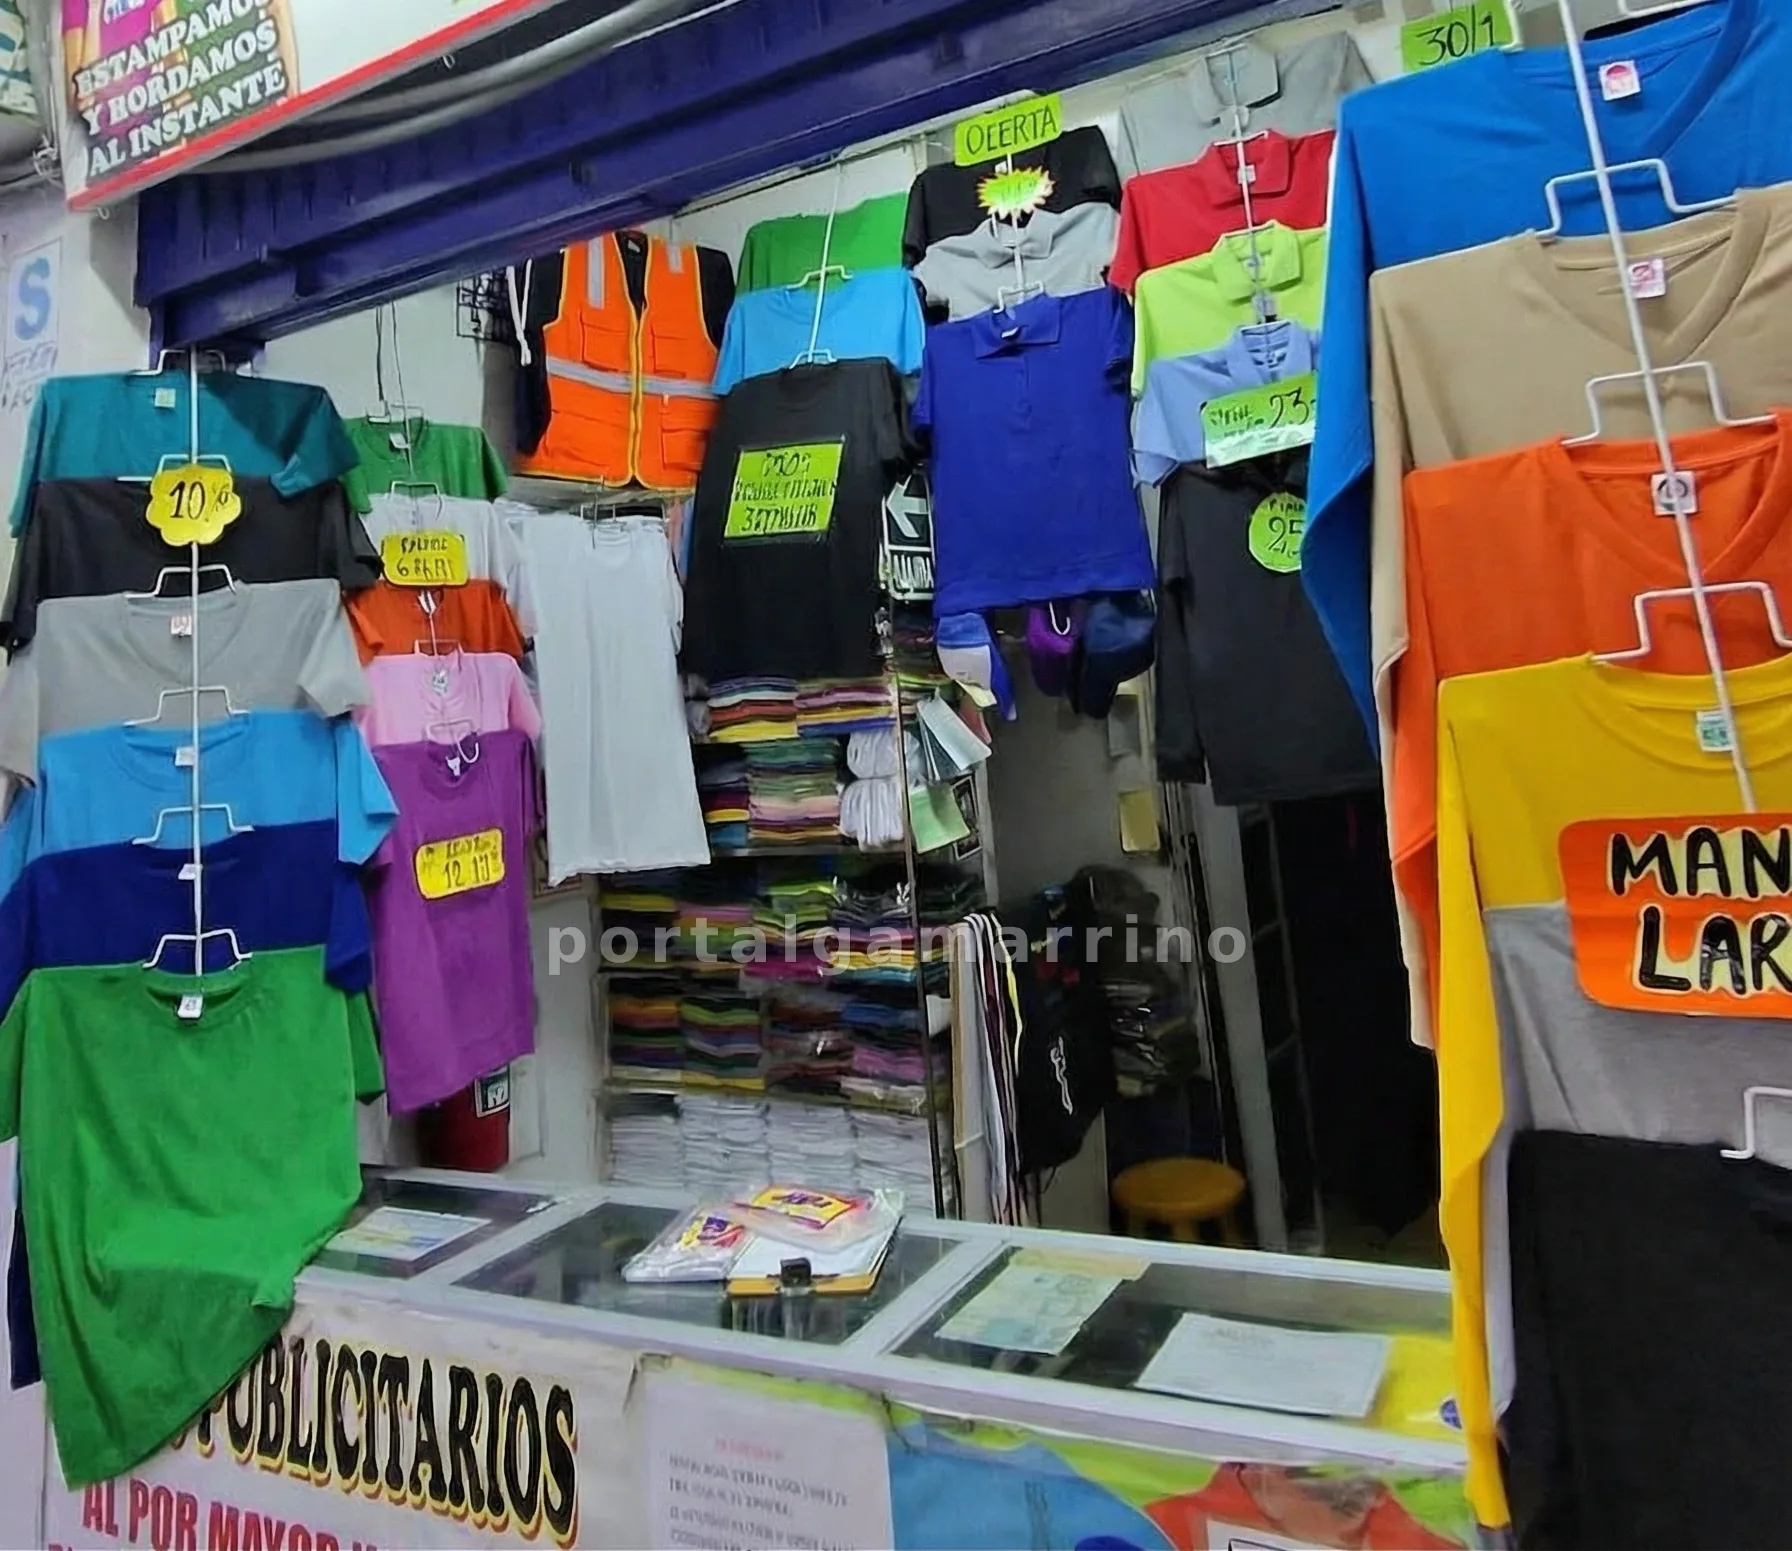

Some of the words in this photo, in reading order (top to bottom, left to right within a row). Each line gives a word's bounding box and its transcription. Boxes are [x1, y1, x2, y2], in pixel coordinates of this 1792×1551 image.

[75, 0, 269, 98] ESTAMPAMO
[83, 103, 103, 136] Y
[108, 20, 277, 126] BORDAMOS
[1417, 5, 1495, 66] 30/1
[90, 138, 125, 177] AL
[128, 63, 286, 158] INSTANTE
[15, 257, 50, 341] S
[1638, 904, 1792, 995] LAR
[82, 1484, 118, 1537] AL
[129, 1478, 198, 1551] POR
